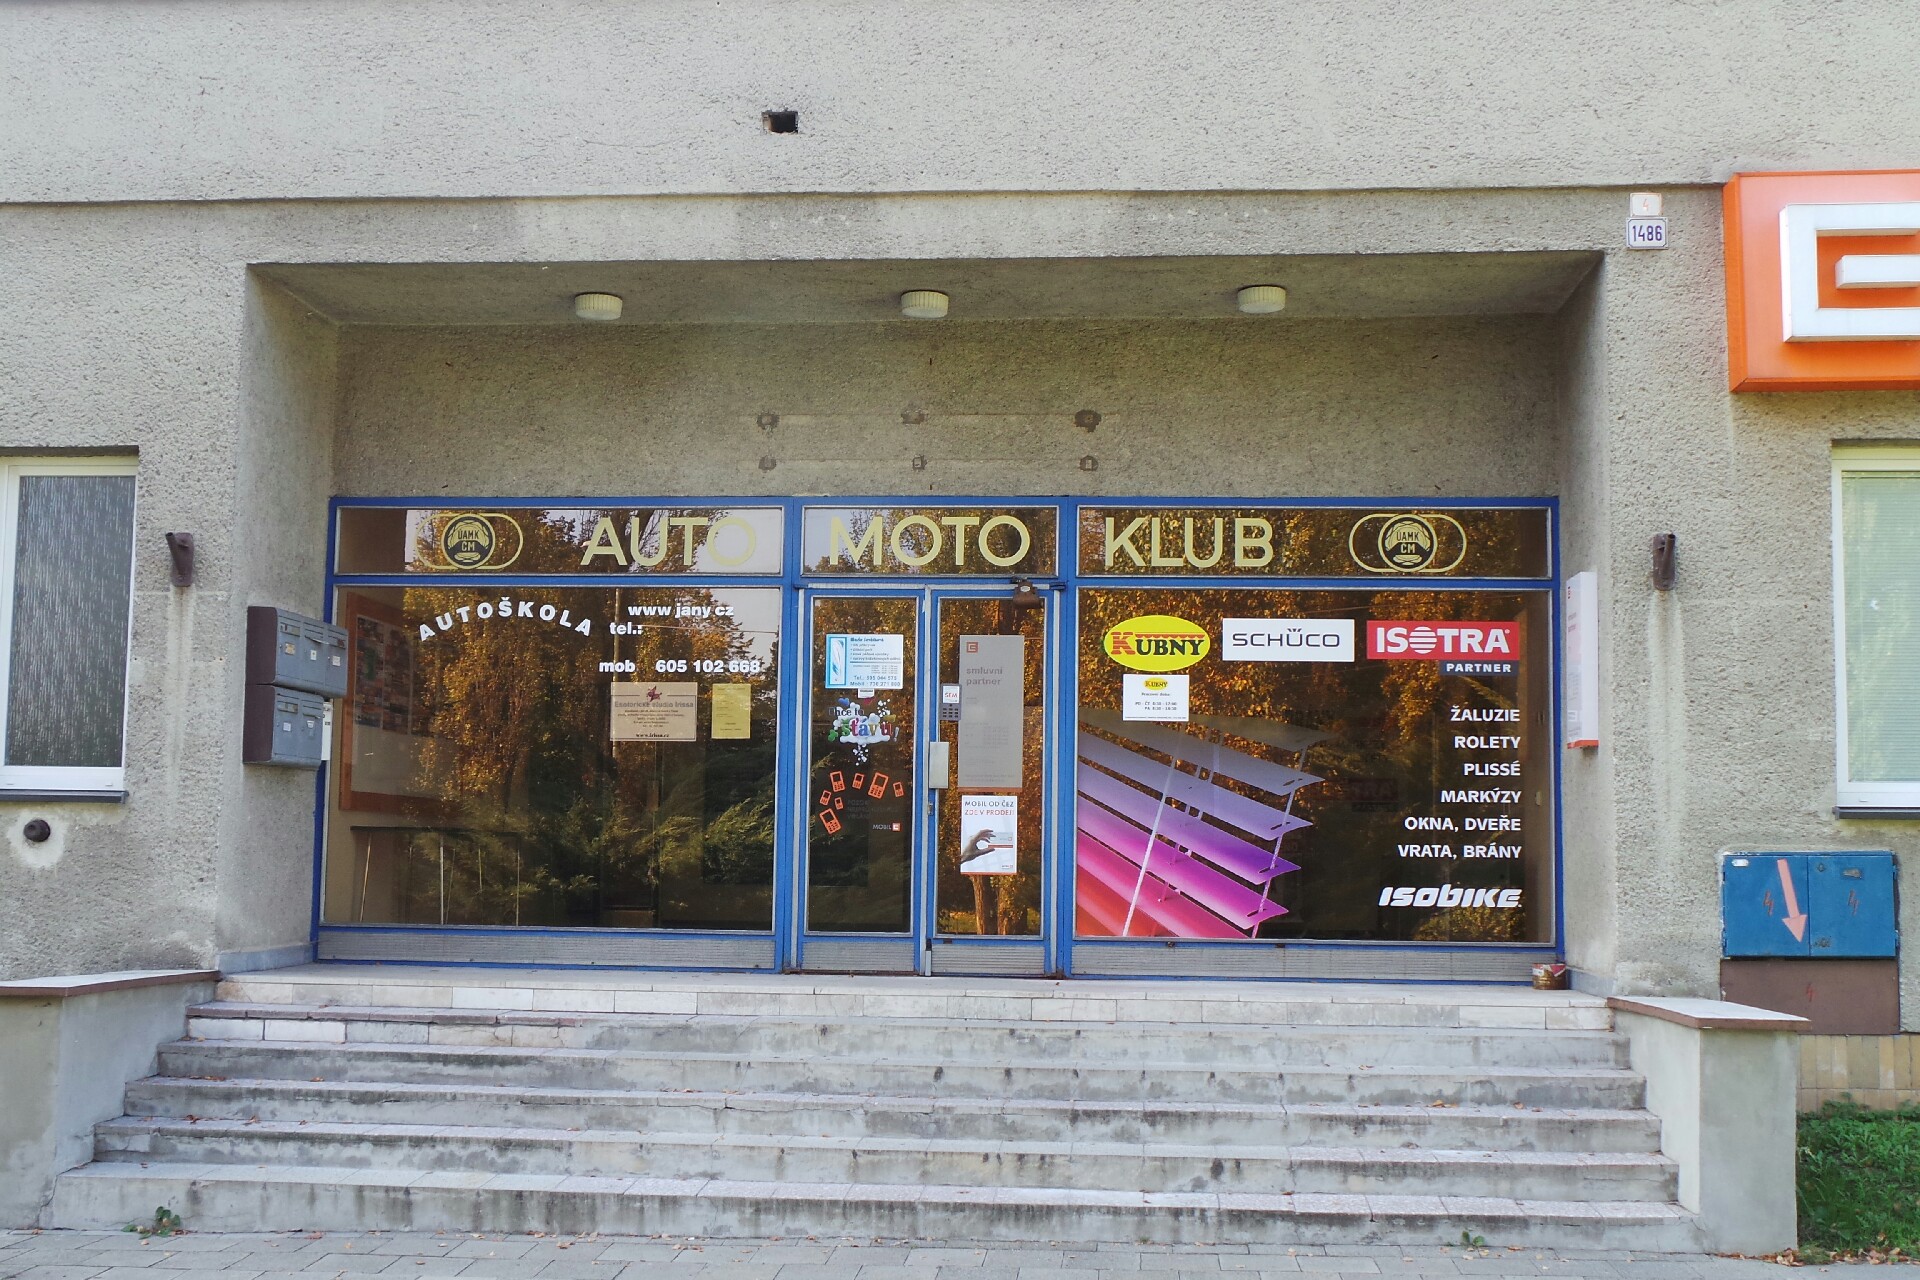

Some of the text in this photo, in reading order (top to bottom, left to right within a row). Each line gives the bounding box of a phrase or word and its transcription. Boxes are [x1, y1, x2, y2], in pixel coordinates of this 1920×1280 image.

[1632, 225, 1663, 242] 1486
[461, 541, 475, 551] CM
[580, 515, 1274, 568] AUTO MOTO KLUB
[1400, 543, 1415, 554] CM
[419, 596, 591, 642] AUTOŠKOLA
[1110, 631, 1206, 656] KUBNY
[1232, 628, 1340, 647] SCHÜCO
[655, 659, 687, 673] 605
[693, 659, 724, 673] 102
[728, 659, 760, 673] 668
[1446, 663, 1511, 673] PARTNER
[966, 678, 1001, 686] partner
[1450, 705, 1521, 722] ŽALUZIE
[1454, 735, 1521, 749] ROLETY
[1463, 760, 1521, 776] PLISSÉ
[1440, 787, 1522, 803] MARKÝZY
[1404, 815, 1521, 832] OKNA, DVEŘE
[1398, 842, 1522, 859] VRATA, BRÁNY
